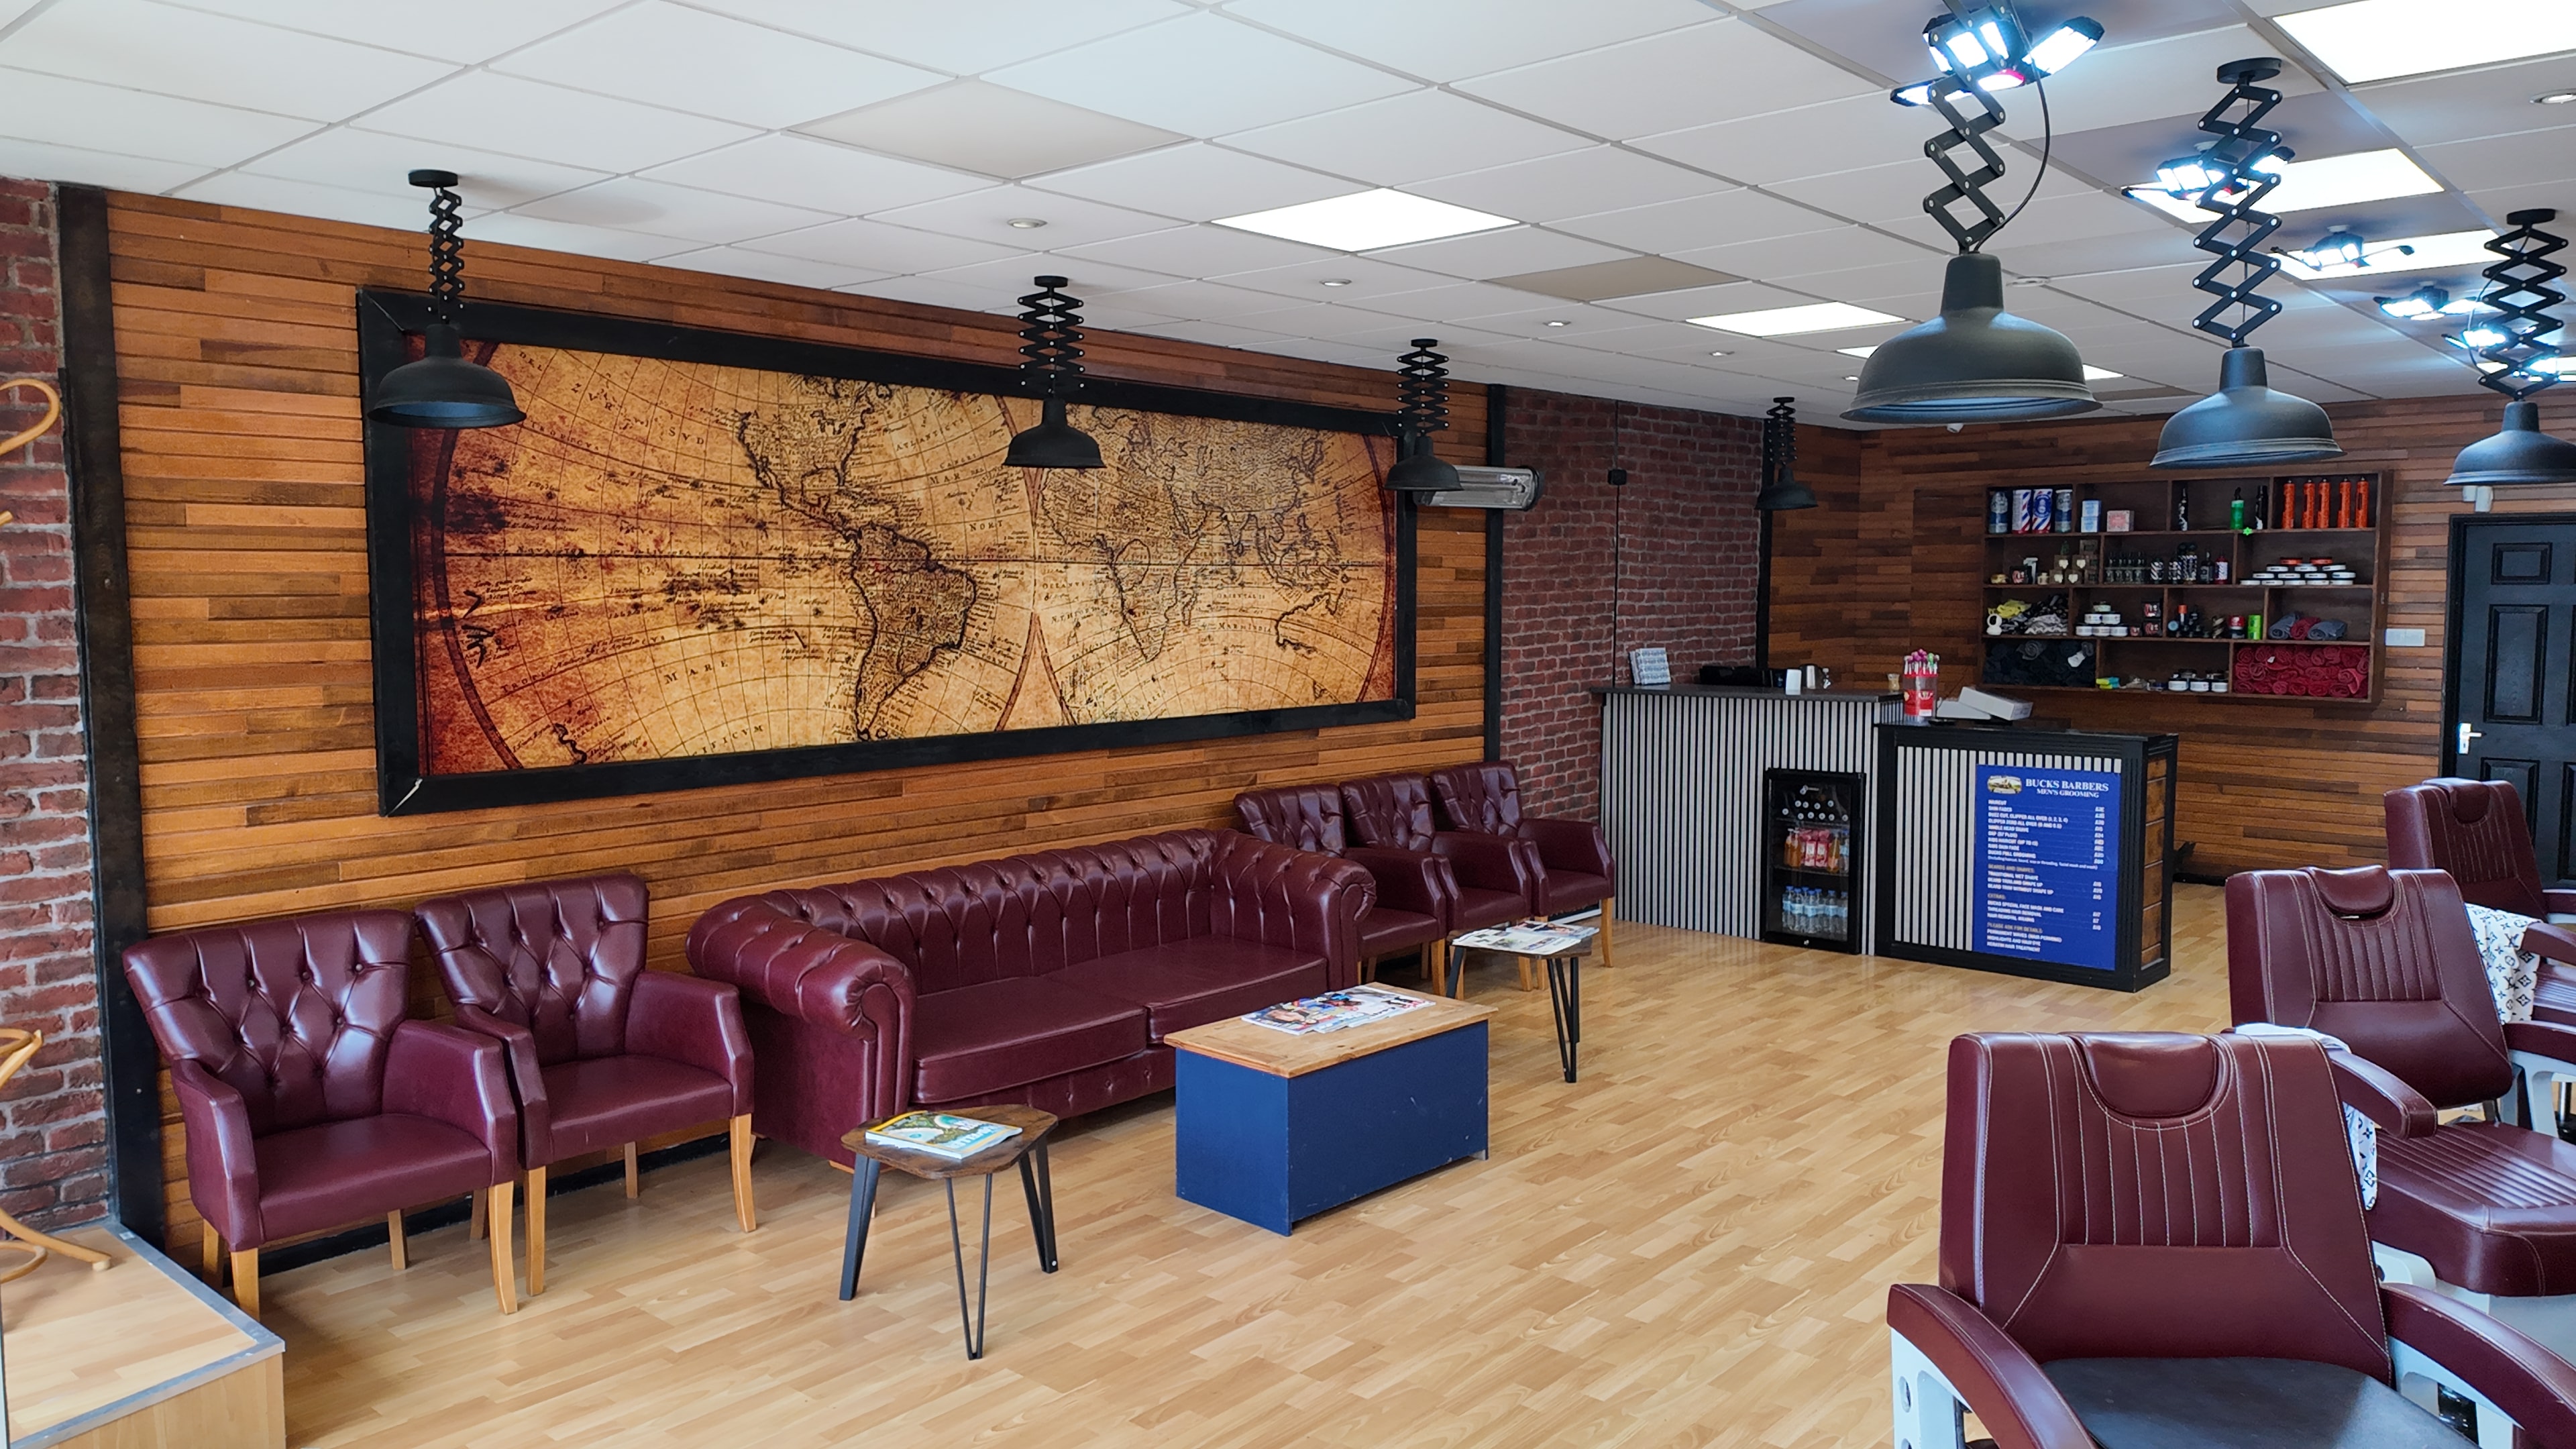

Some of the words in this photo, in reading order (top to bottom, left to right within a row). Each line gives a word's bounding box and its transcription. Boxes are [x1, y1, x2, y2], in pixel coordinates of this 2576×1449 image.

[930, 472, 961, 486] MAR
[664, 659, 729, 685] MARE
[2025, 778, 2059, 789] BUCKS
[2061, 780, 2109, 792] BARBERS
[2059, 790, 2100, 799] GROOMING
